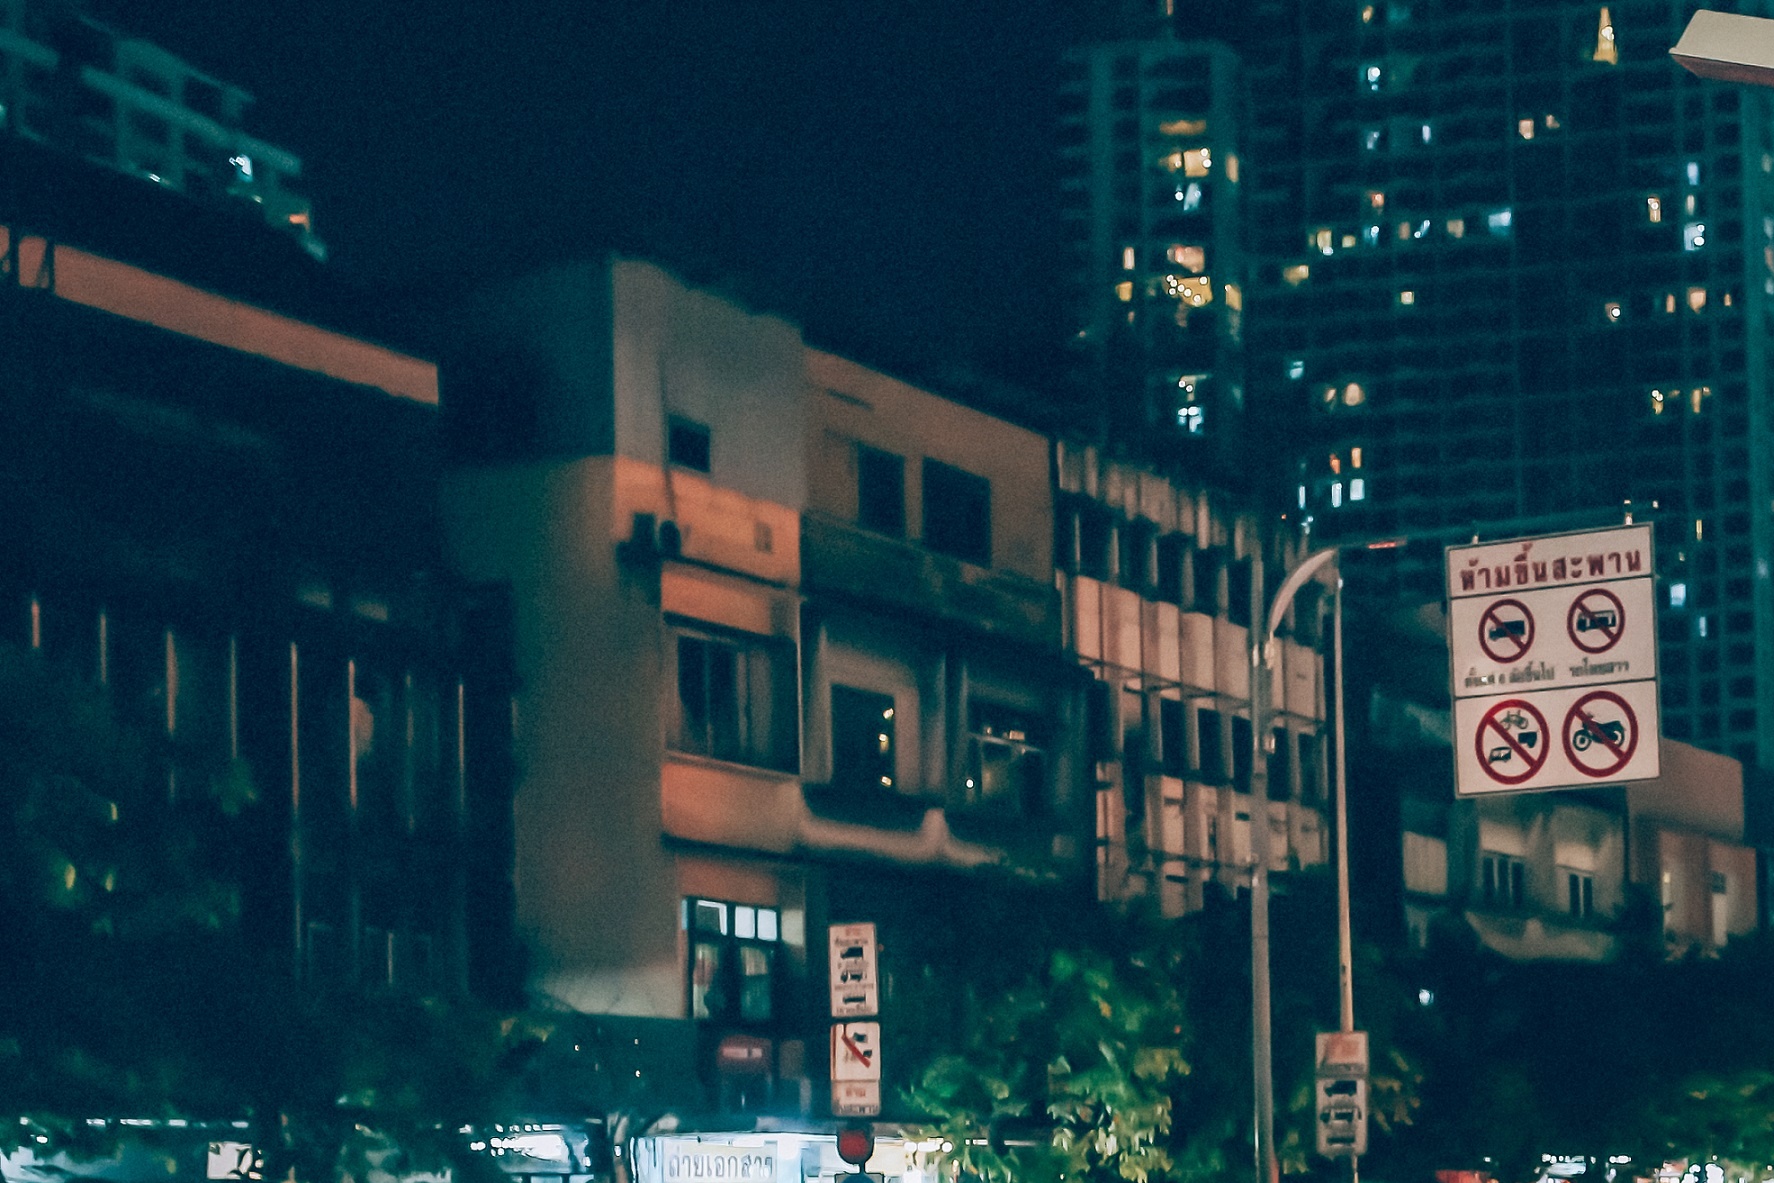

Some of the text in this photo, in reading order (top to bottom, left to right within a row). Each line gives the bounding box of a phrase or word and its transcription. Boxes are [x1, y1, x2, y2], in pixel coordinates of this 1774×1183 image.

[1460, 543, 1642, 591] ห้ามขึ้นสะพาน
[669, 1146, 773, 1178] ถ่ายเอกสาร
